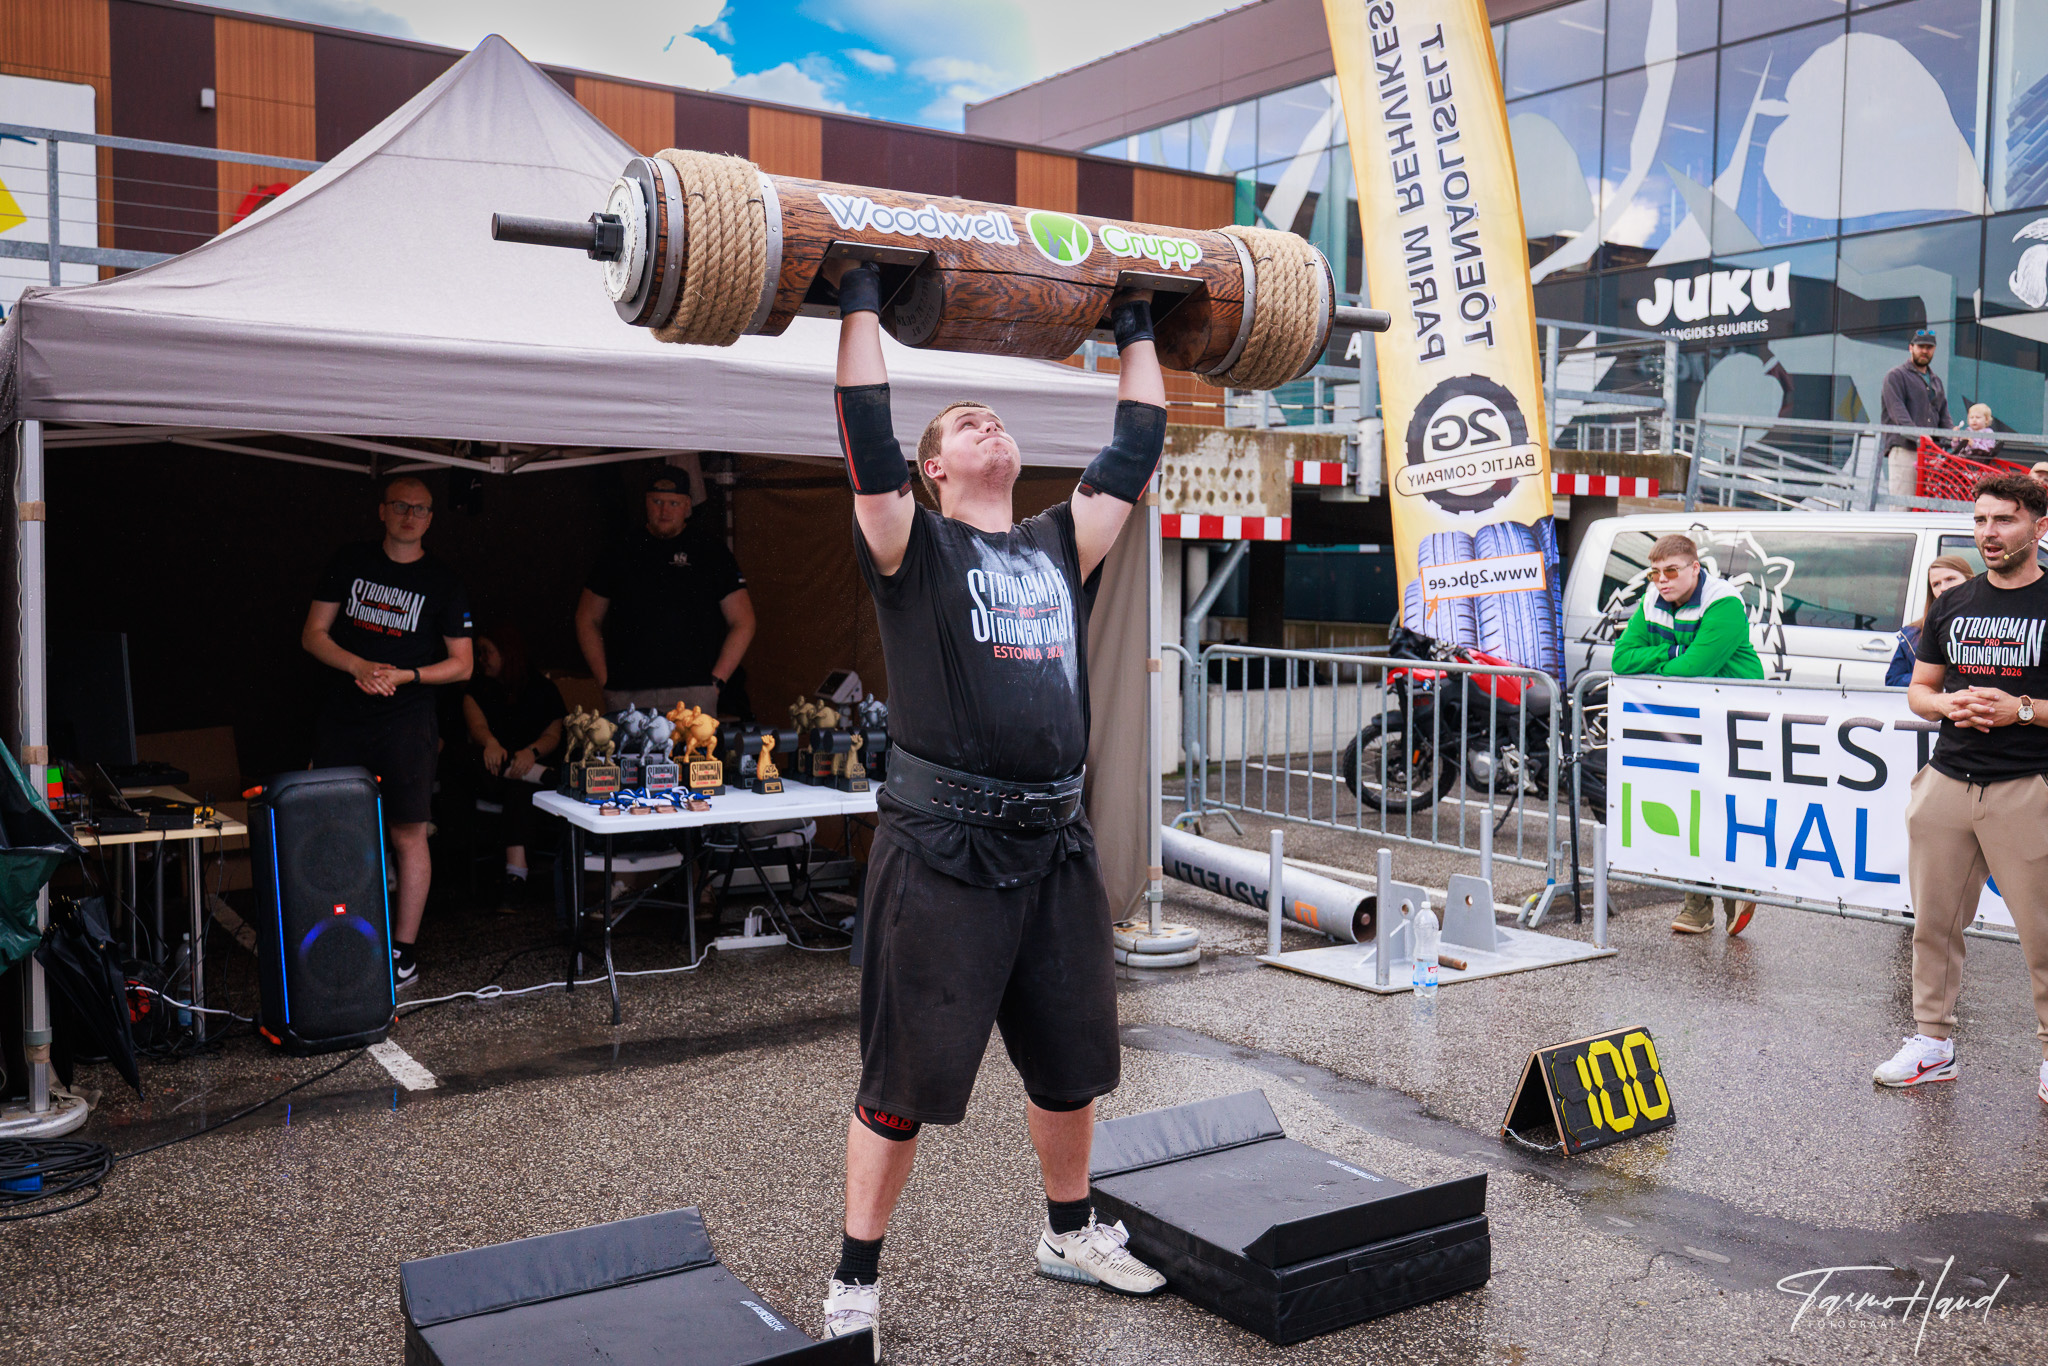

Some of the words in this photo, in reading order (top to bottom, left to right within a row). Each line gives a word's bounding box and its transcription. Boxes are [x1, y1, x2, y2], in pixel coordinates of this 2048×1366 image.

[821, 194, 1016, 244] Woodwell
[1102, 226, 1201, 268] Grupp
[1636, 260, 1792, 327] JUKU
[1717, 319, 1769, 336] SUUREKS
[348, 578, 426, 612] STRONGMAN
[967, 568, 1072, 607] STRONGMAN
[346, 598, 418, 633] STRONGWOMAN
[970, 606, 1074, 645] STRONGWOMAN
[1018, 607, 1036, 619] PRO
[1948, 616, 2046, 643] STRONGMAN
[1983, 638, 2000, 647] PRO
[993, 645, 1043, 660] ESTONIA
[1046, 646, 1064, 660] 2026
[1947, 642, 2042, 667] STRONGWOMAN
[1958, 665, 1996, 675] ESTONIA
[2000, 667, 2023, 677] 2026
[1576, 1031, 1671, 1133] 100
[878, 1111, 912, 1128] SBD
